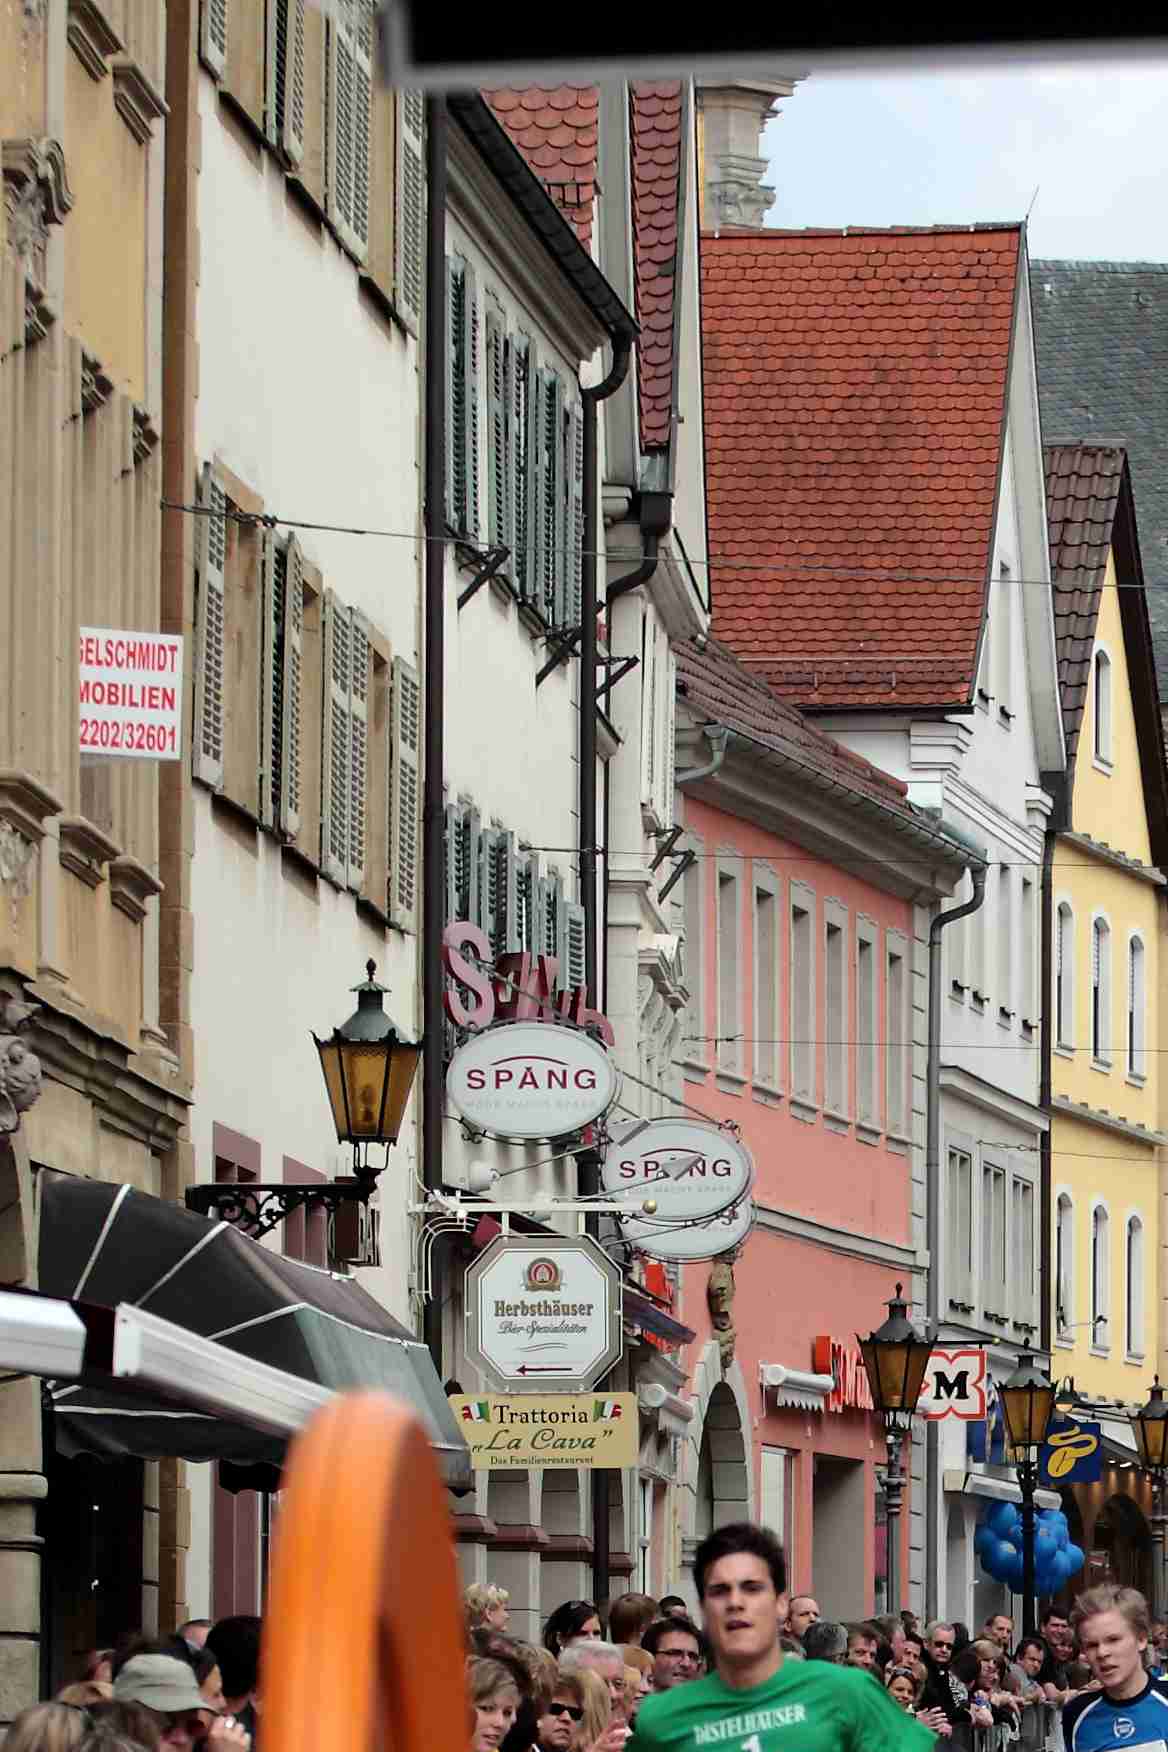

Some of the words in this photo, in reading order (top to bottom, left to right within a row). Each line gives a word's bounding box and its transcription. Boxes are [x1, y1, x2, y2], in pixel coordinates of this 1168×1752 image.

[619, 1157, 732, 1178] SPNG
[494, 1299, 594, 1318] Herbsthäuser
[933, 1370, 969, 1400] M
[493, 1404, 588, 1424] Trattoria
